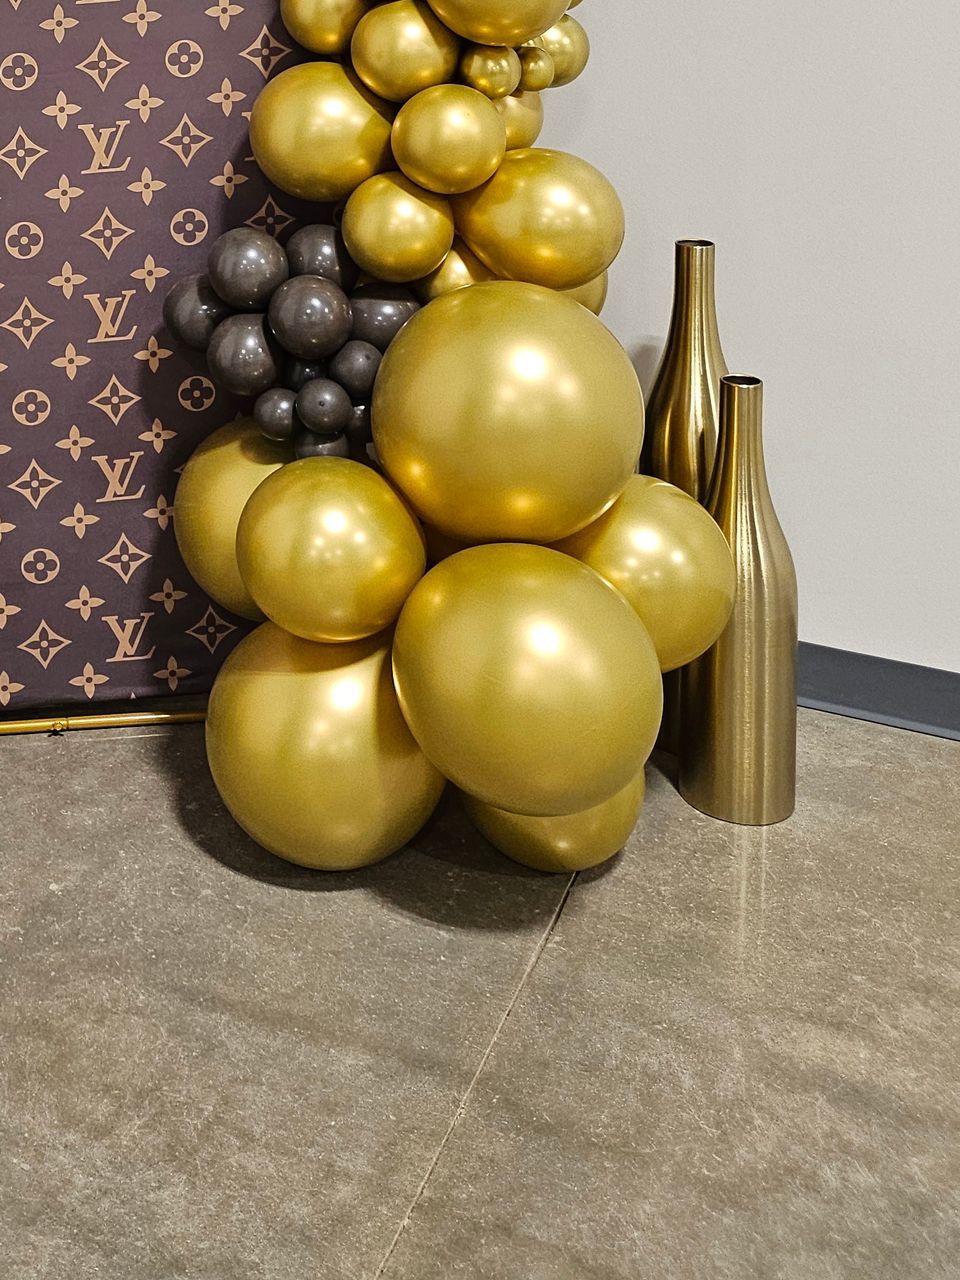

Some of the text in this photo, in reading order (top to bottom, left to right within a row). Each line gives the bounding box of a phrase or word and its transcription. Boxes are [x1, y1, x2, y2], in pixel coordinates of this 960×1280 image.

[77, 120, 131, 175] LV
[83, 290, 137, 343] LV
[91, 451, 145, 503] LV
[101, 612, 156, 663] LV
